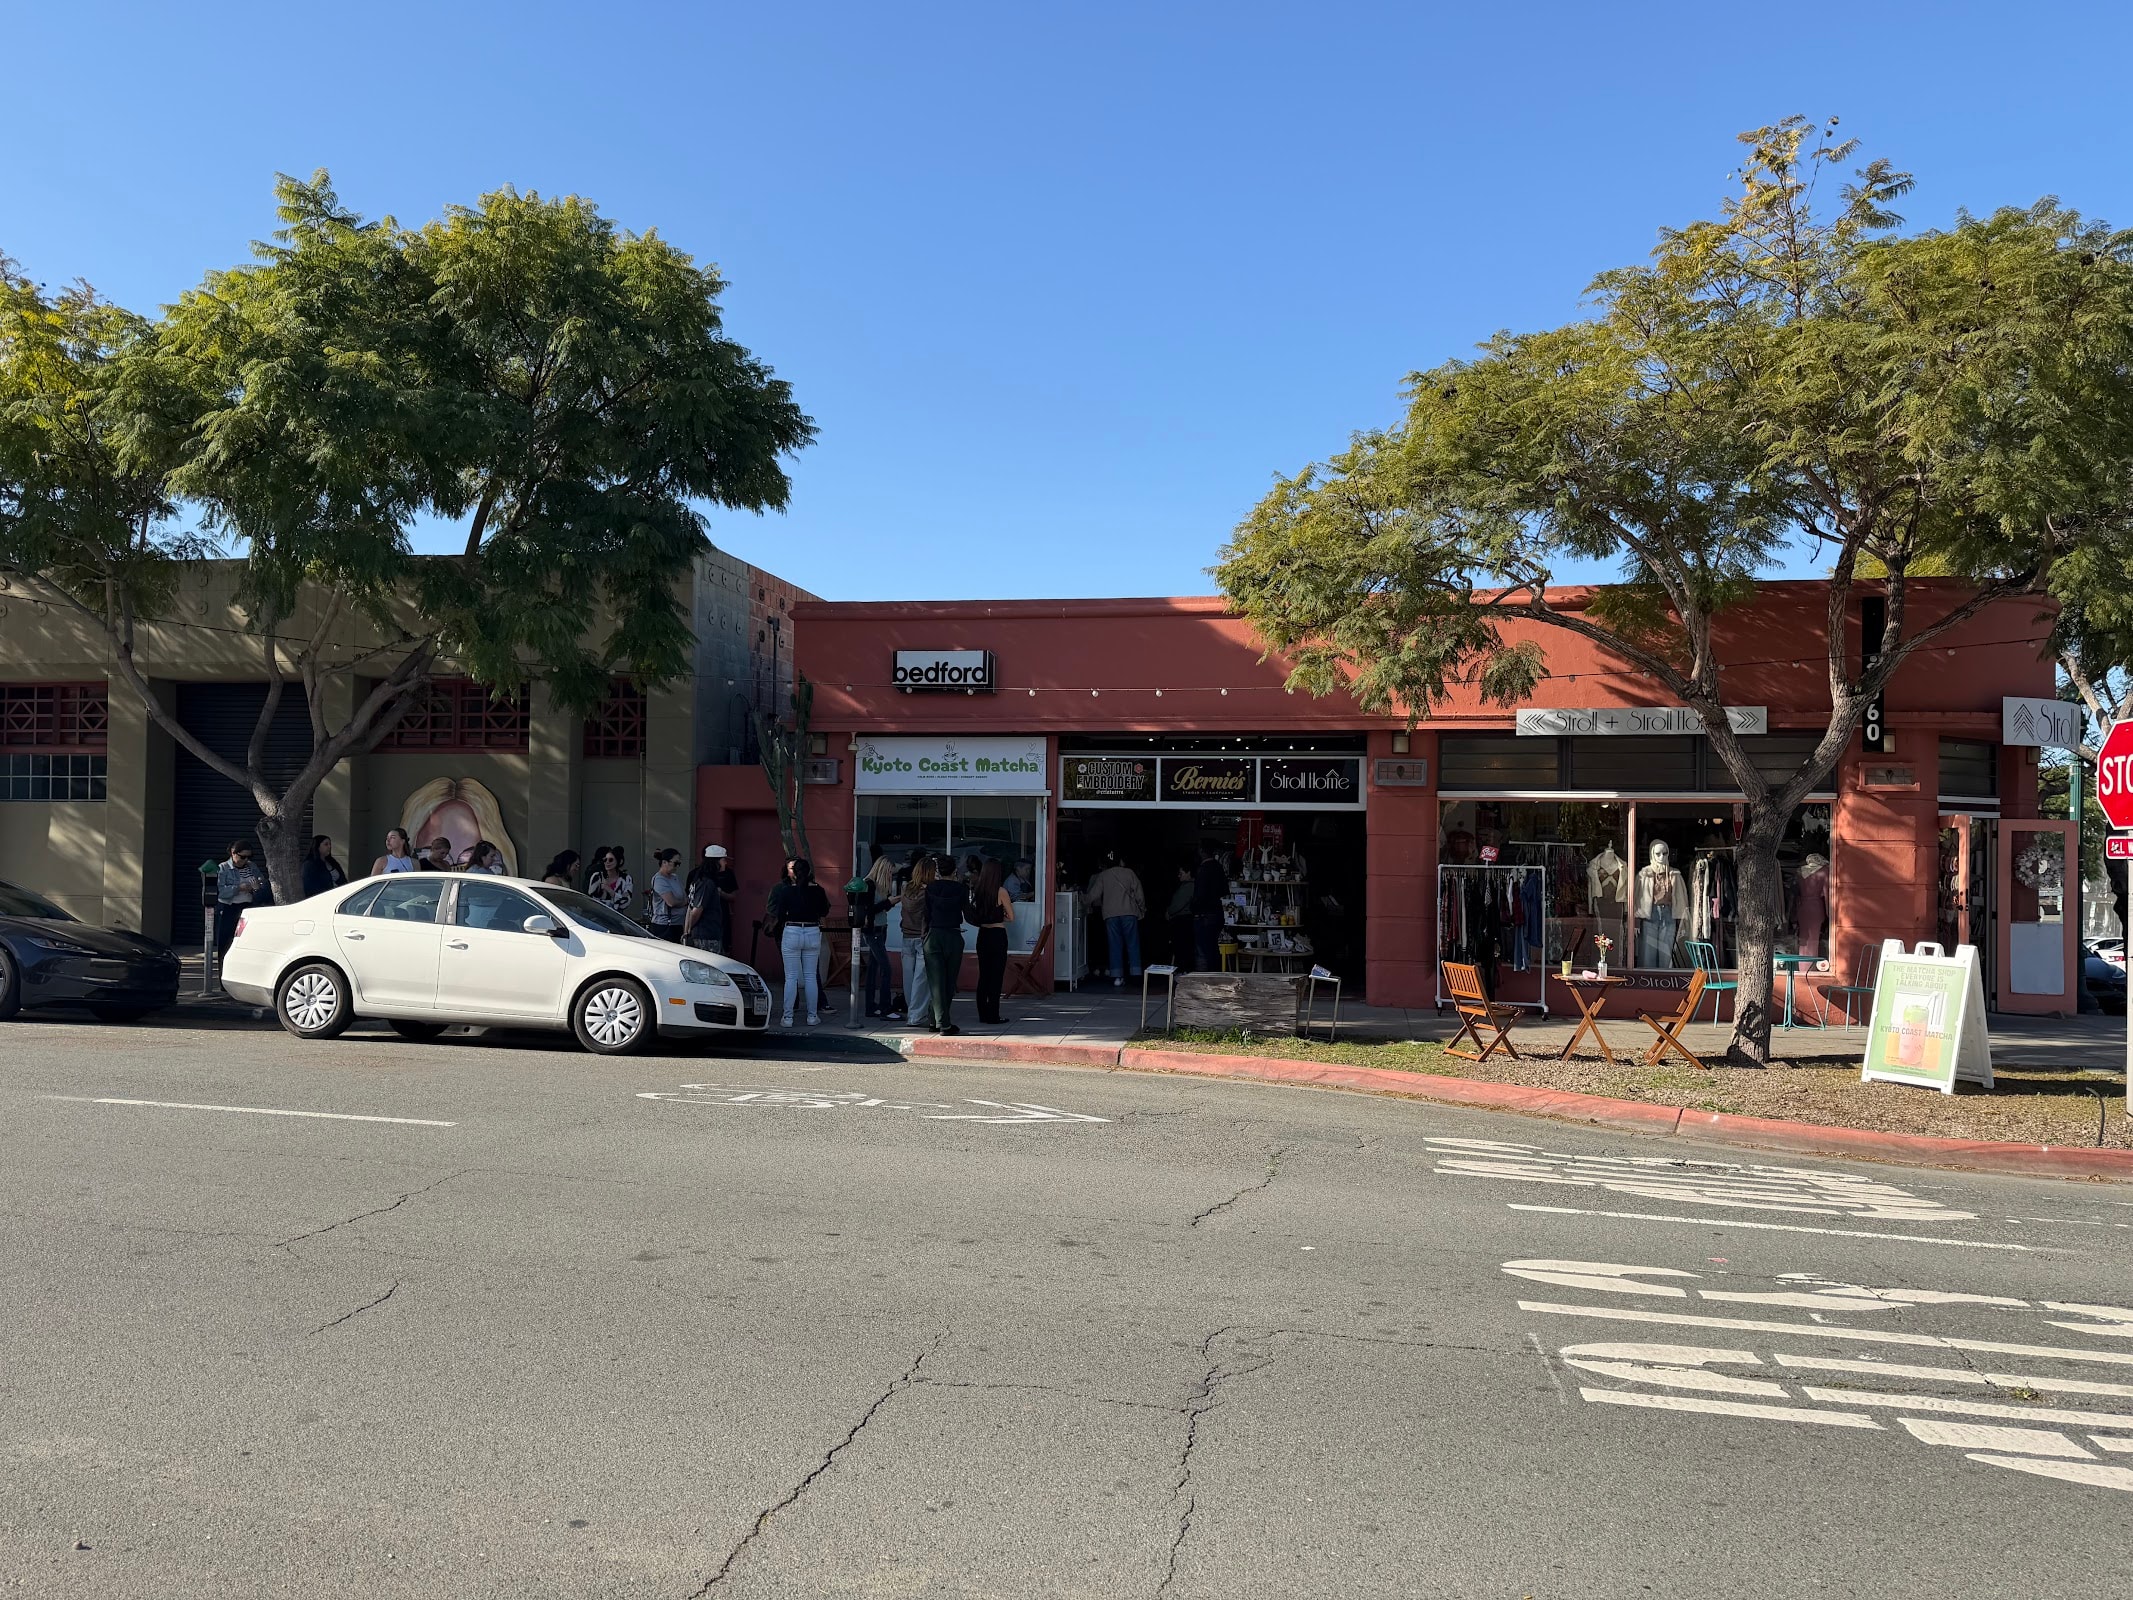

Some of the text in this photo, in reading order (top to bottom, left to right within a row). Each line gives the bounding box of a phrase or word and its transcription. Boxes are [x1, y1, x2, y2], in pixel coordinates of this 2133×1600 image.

[893, 660, 987, 683] bedford
[1553, 711, 1598, 732] Stroll
[1627, 711, 1672, 731] Stroll
[1677, 711, 1705, 730] Ho
[862, 757, 1039, 774] Kyoto Coast Matcha
[1088, 761, 1133, 775] CUSTOM
[1077, 774, 1145, 790] EMBROIDERY
[1170, 765, 1246, 791] Bernie's
[1270, 769, 1350, 790] Stroll Home
[2101, 753, 2133, 796] STO
[1893, 965, 1957, 977] THE MATCHA SHOP
[1900, 972, 1936, 982] EVERYONE
[1639, 975, 1678, 988] Stroll
[1896, 978, 1949, 990] TALKING ABOUT
[1880, 1025, 1953, 1041] KYOTO COAST MATCHA
